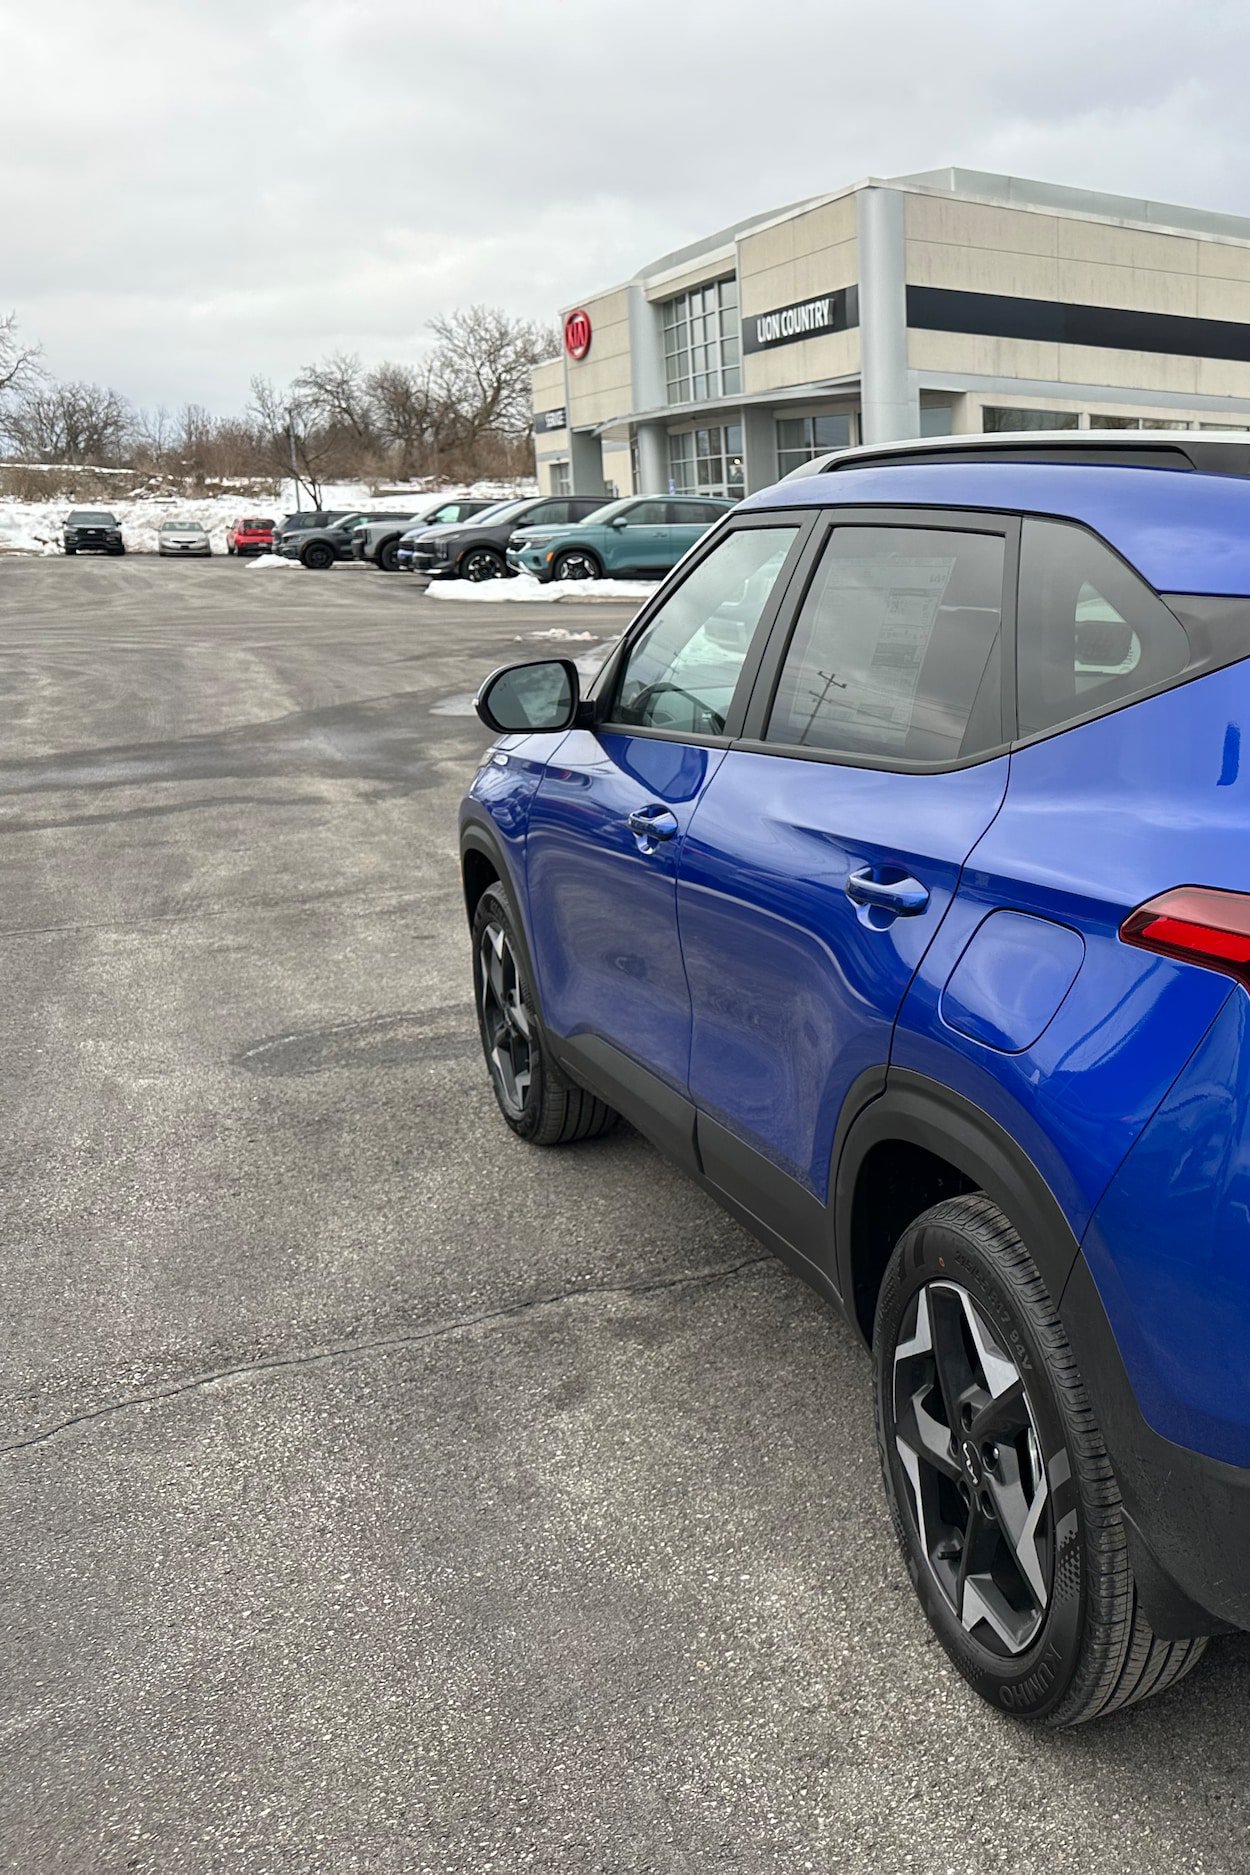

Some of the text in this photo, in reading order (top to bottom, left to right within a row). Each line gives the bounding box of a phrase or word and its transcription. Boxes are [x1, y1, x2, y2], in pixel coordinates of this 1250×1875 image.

[757, 299, 830, 343] LION COUNTRY
[1000, 1642, 1062, 1706] KUMHO
